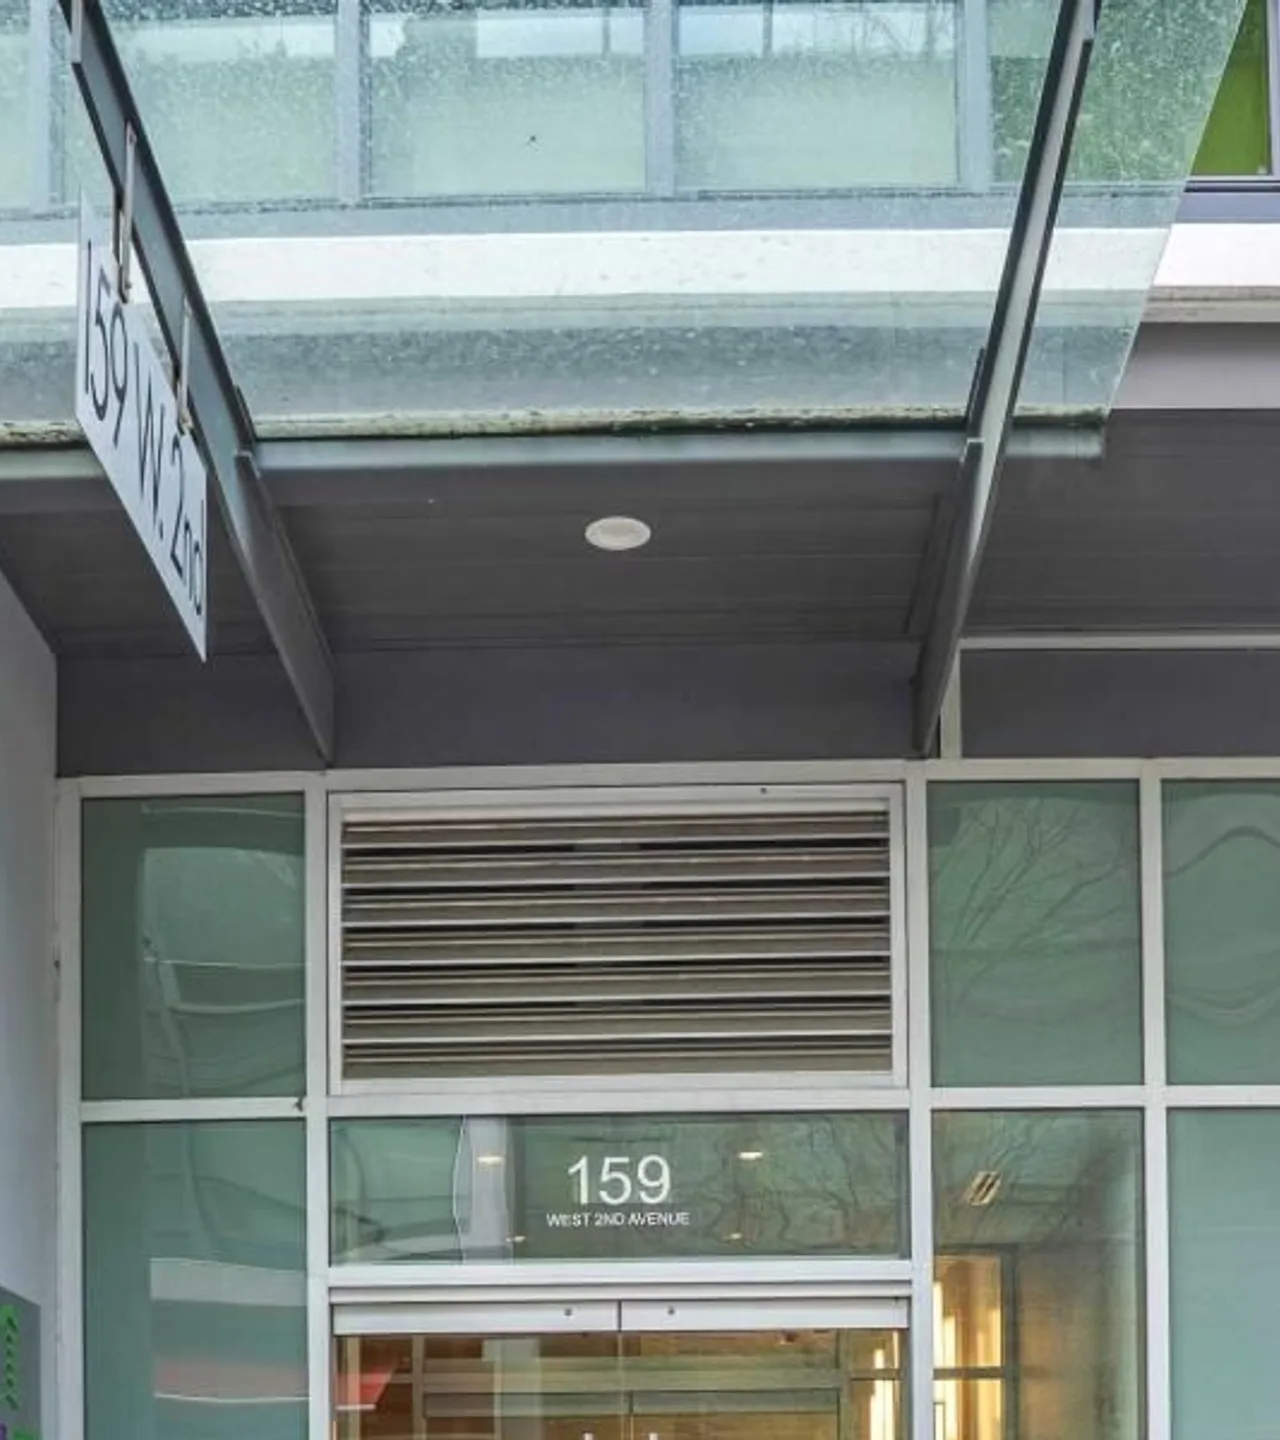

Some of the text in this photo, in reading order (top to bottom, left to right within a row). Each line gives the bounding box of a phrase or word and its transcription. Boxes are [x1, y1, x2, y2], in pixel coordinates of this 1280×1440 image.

[84, 238, 129, 448] 159
[171, 445, 204, 616] 2nd
[568, 1155, 671, 1205] 159
[547, 1212, 690, 1227] WEST 2ND AVENUE
